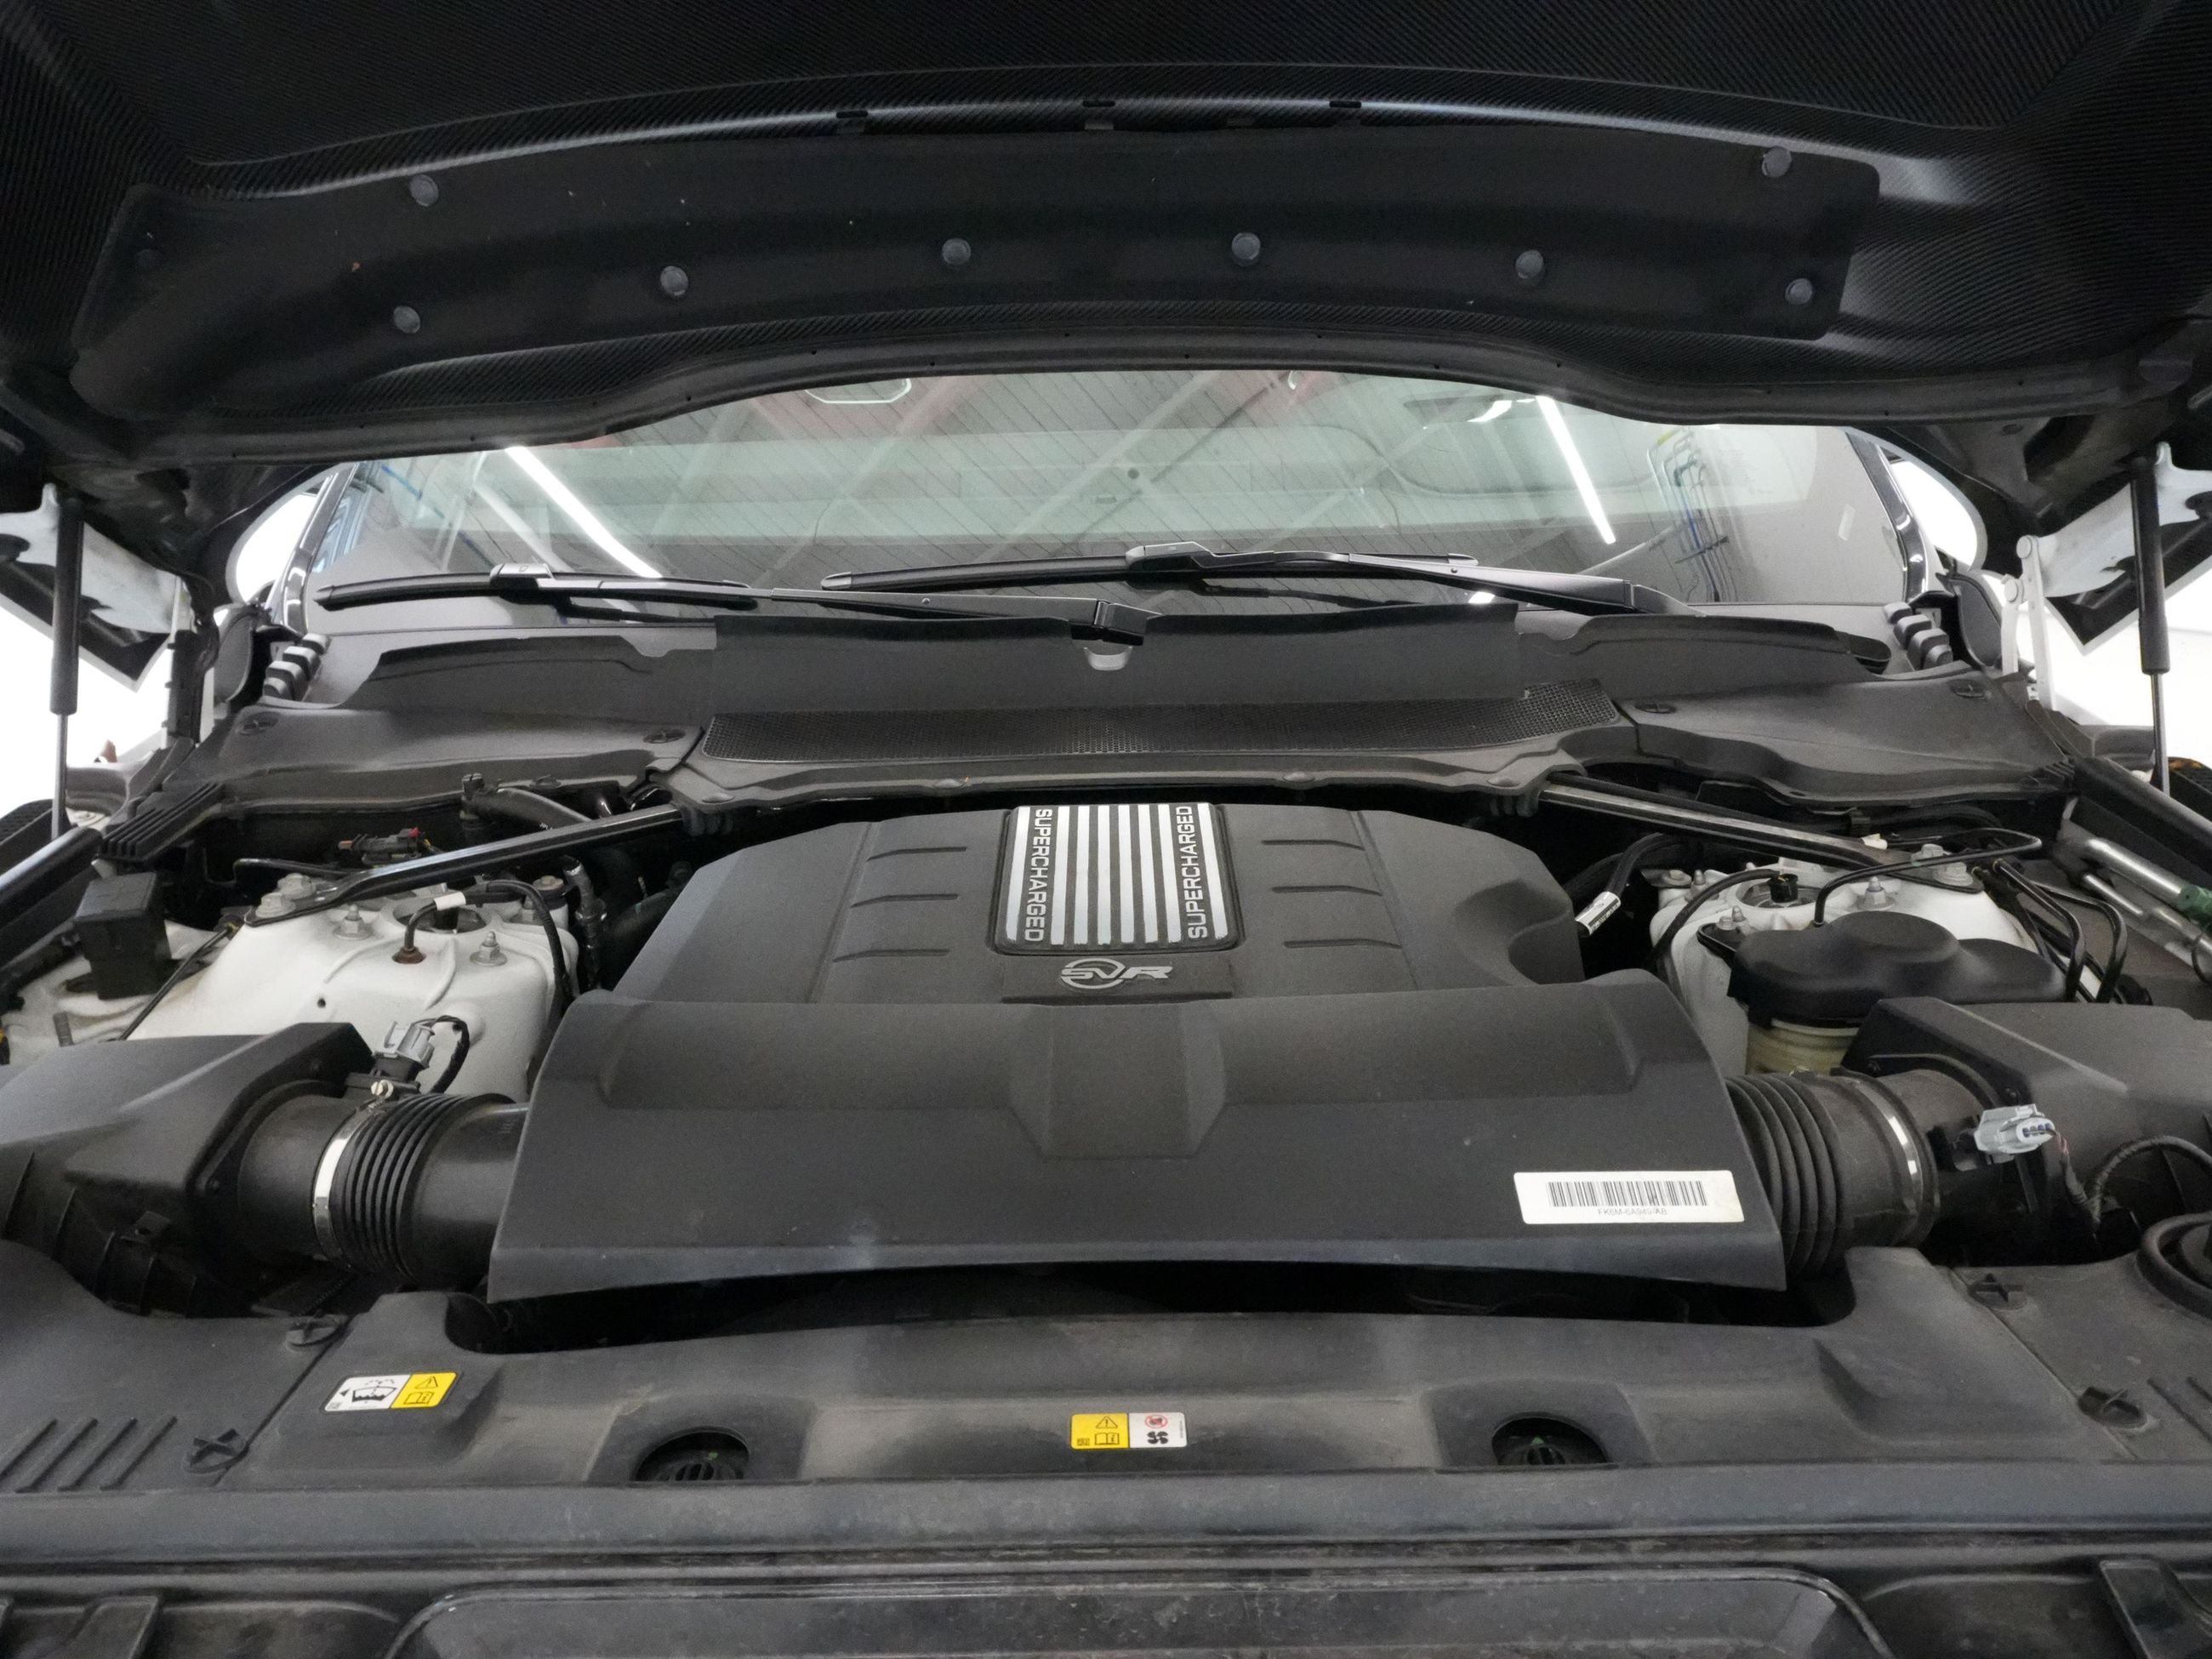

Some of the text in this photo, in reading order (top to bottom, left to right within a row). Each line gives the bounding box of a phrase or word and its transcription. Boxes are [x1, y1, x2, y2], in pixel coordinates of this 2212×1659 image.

[1024, 808, 1052, 942] SUPERCHARGED
[1175, 806, 1207, 939] SUPERCHARGED
[1060, 963, 1173, 981] SVR
